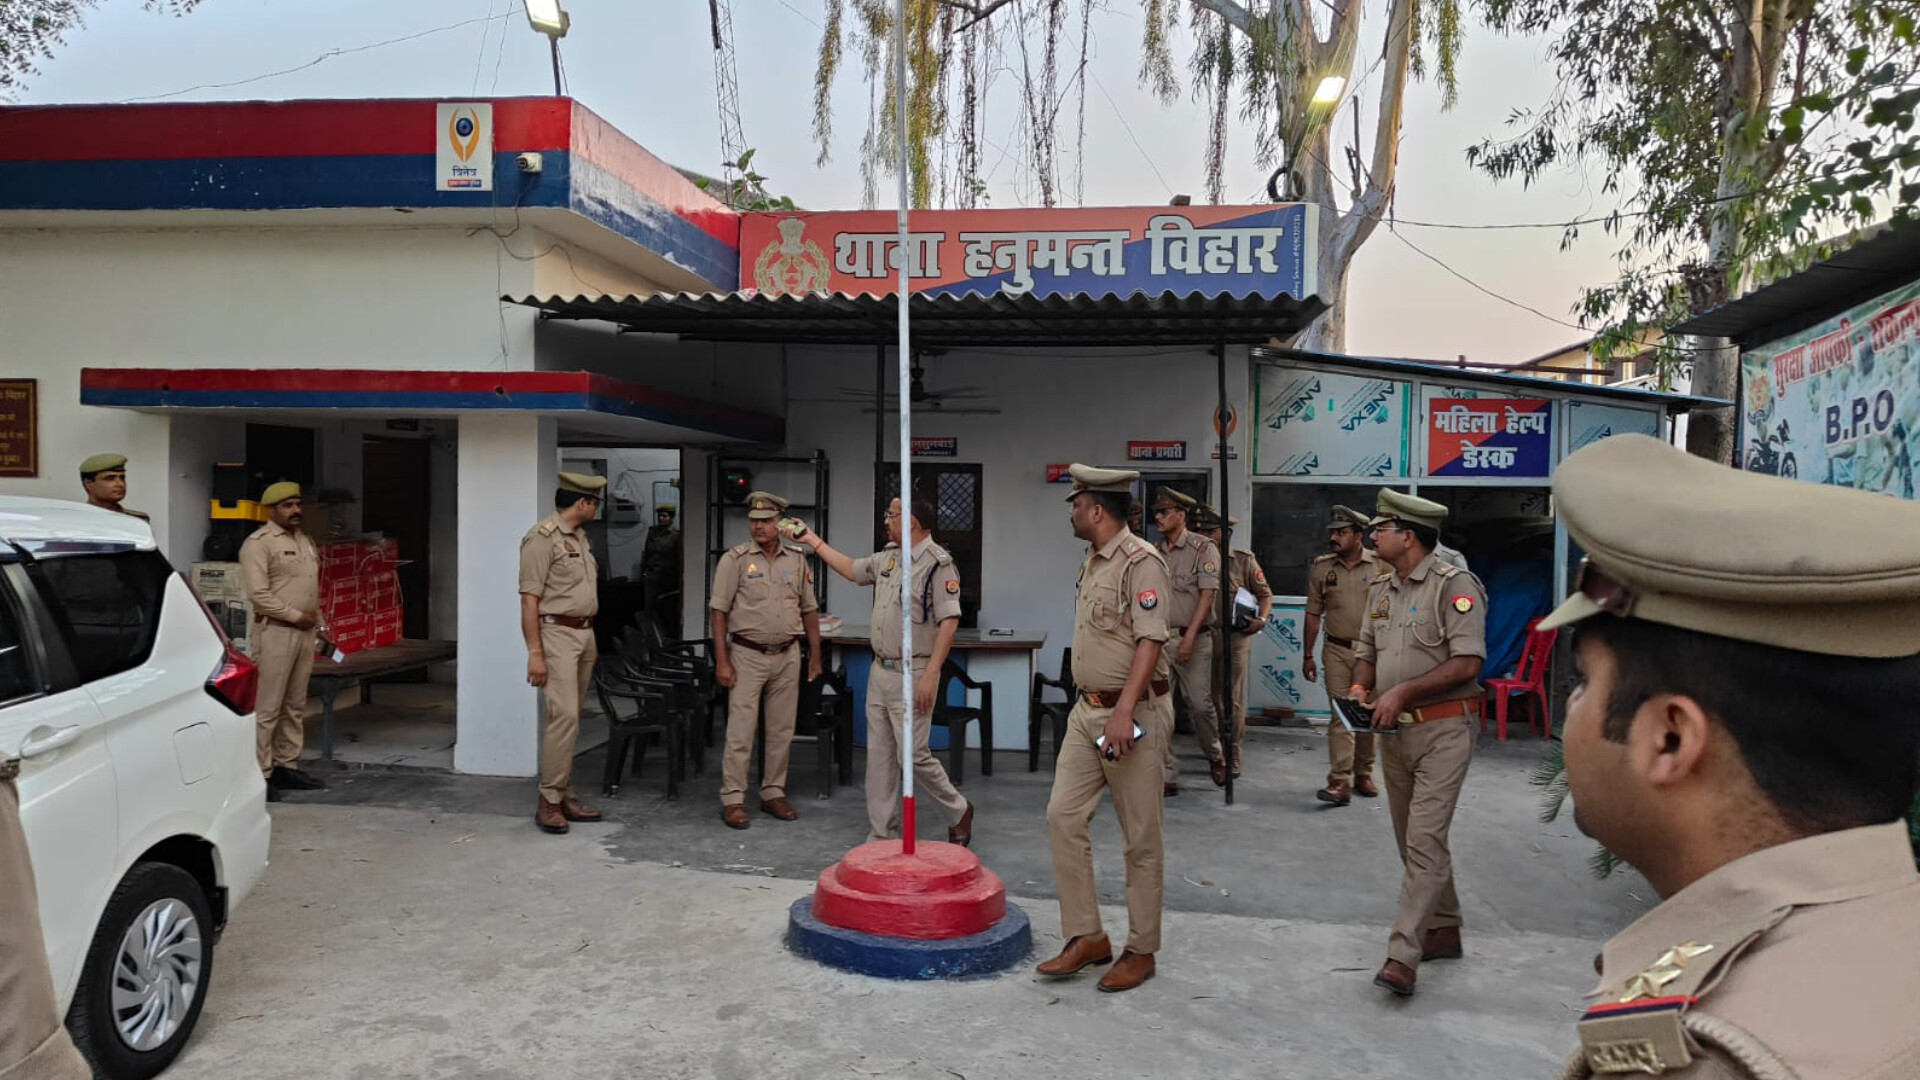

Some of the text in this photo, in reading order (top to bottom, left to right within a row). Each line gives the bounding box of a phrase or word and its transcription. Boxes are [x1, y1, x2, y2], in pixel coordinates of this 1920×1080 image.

[834, 232, 946, 279] थाना
[959, 230, 1130, 295] हनुमन्त
[1145, 215, 1284, 276] विहार
[1809, 317, 1853, 374] आपकी
[1433, 405, 1548, 435] महिला हेल्प
[1826, 389, 1895, 444] B.P.O
[1130, 445, 1153, 459] थाना
[1460, 440, 1518, 470] डेस्क
